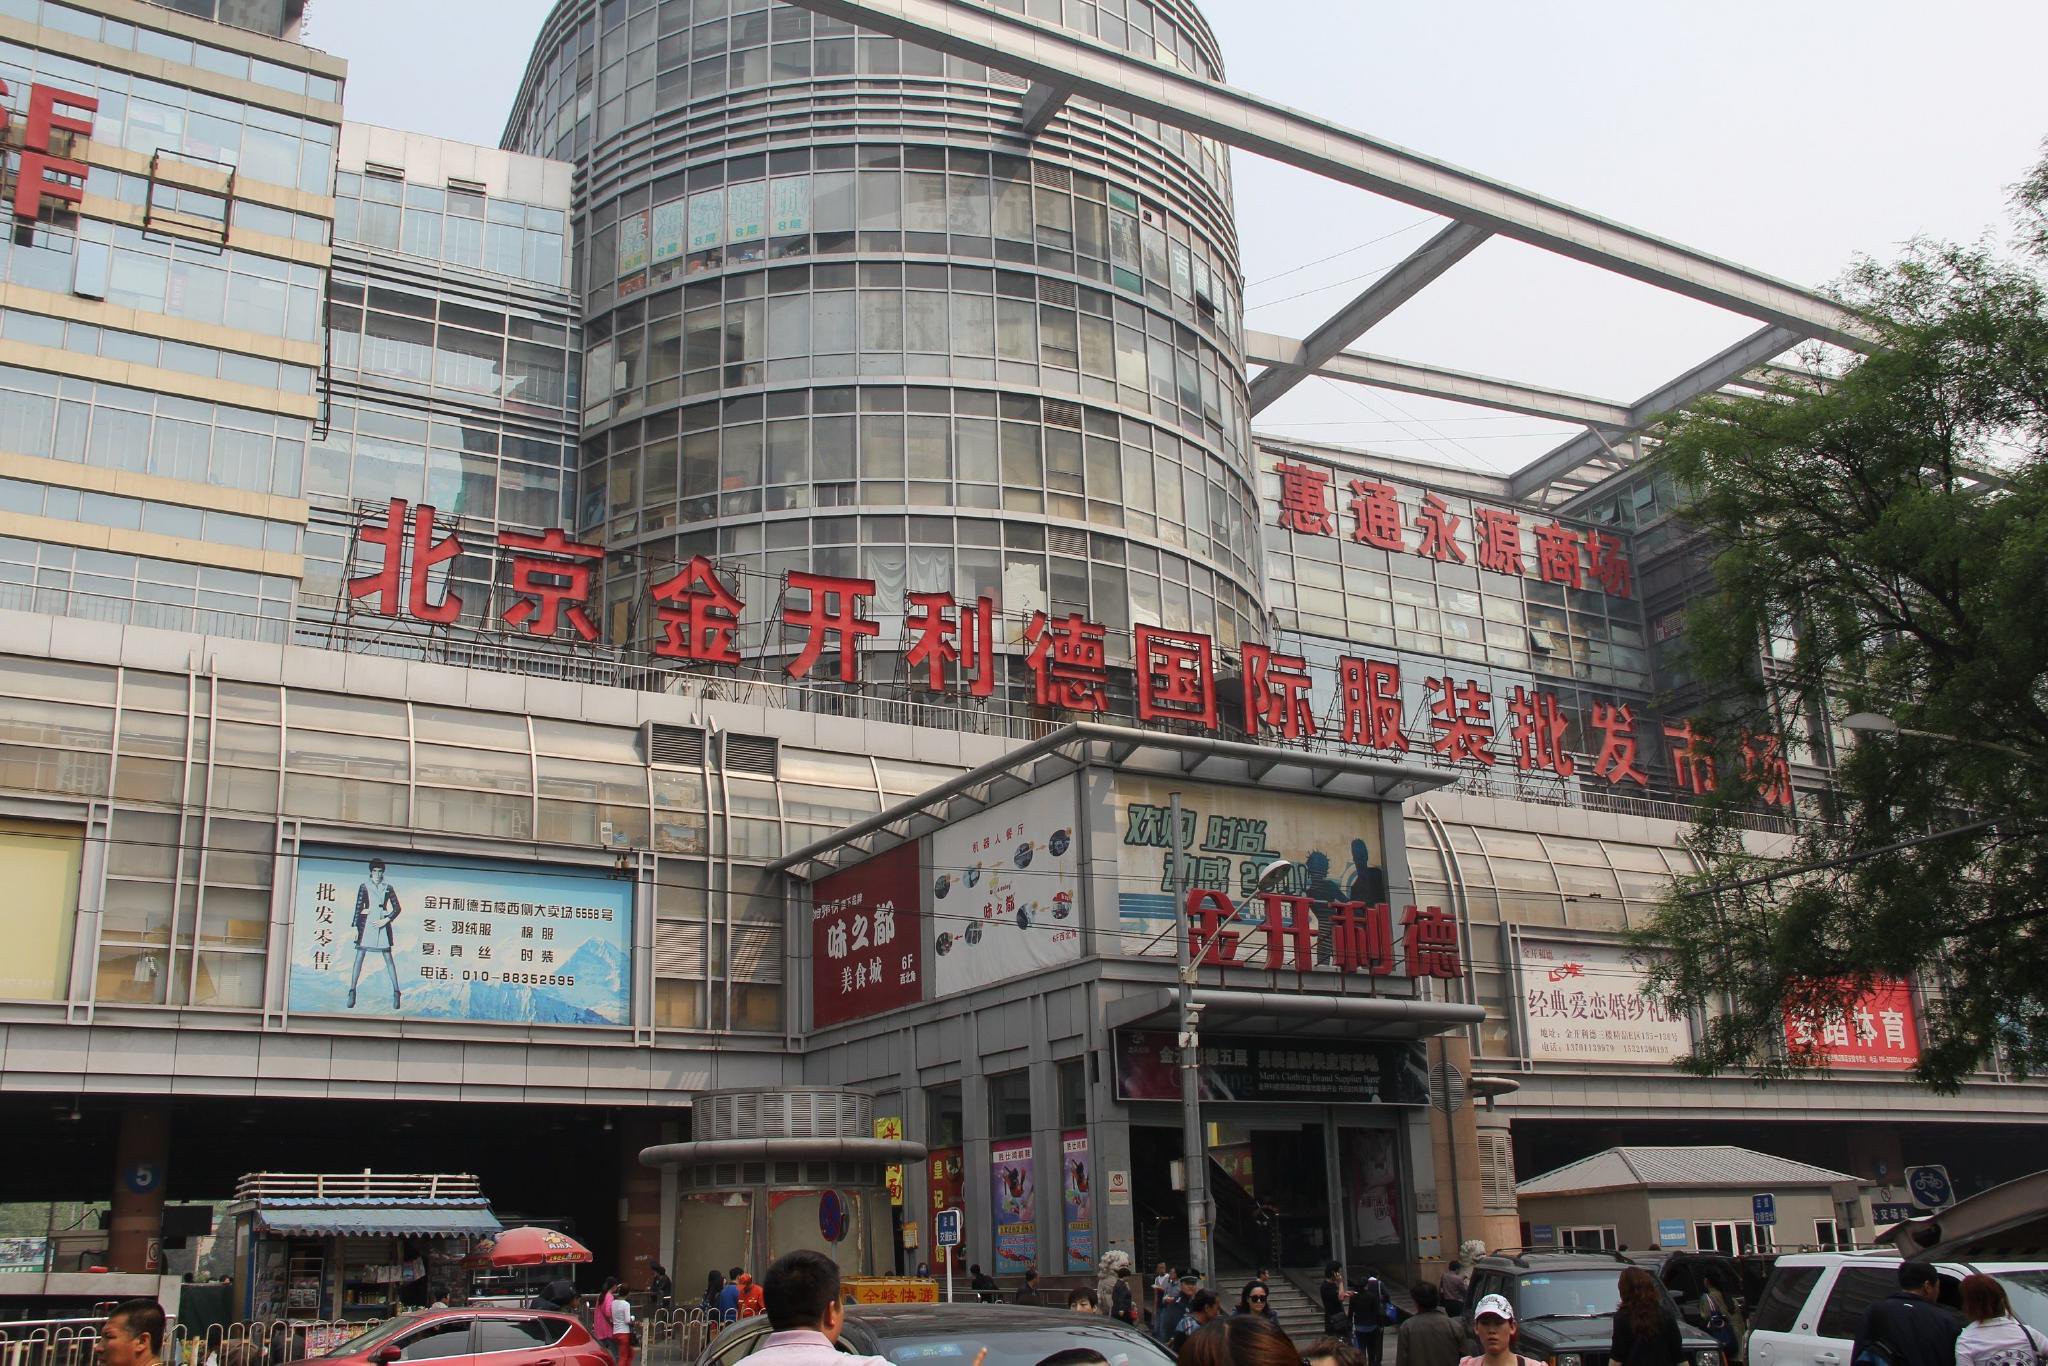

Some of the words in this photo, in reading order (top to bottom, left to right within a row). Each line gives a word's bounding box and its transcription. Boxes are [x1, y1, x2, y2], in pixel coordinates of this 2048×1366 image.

[1276, 461, 1632, 599] 惠通永源商场
[347, 496, 1794, 806] 北京金开利德国际服装批发市场
[1203, 814, 1269, 855] 时尚
[312, 882, 336, 971] 批发零售
[1186, 888, 1464, 979] 金开利德
[841, 956, 882, 994] 美食城
[901, 953, 913, 970] 6F
[135, 1166, 152, 1186] 5
